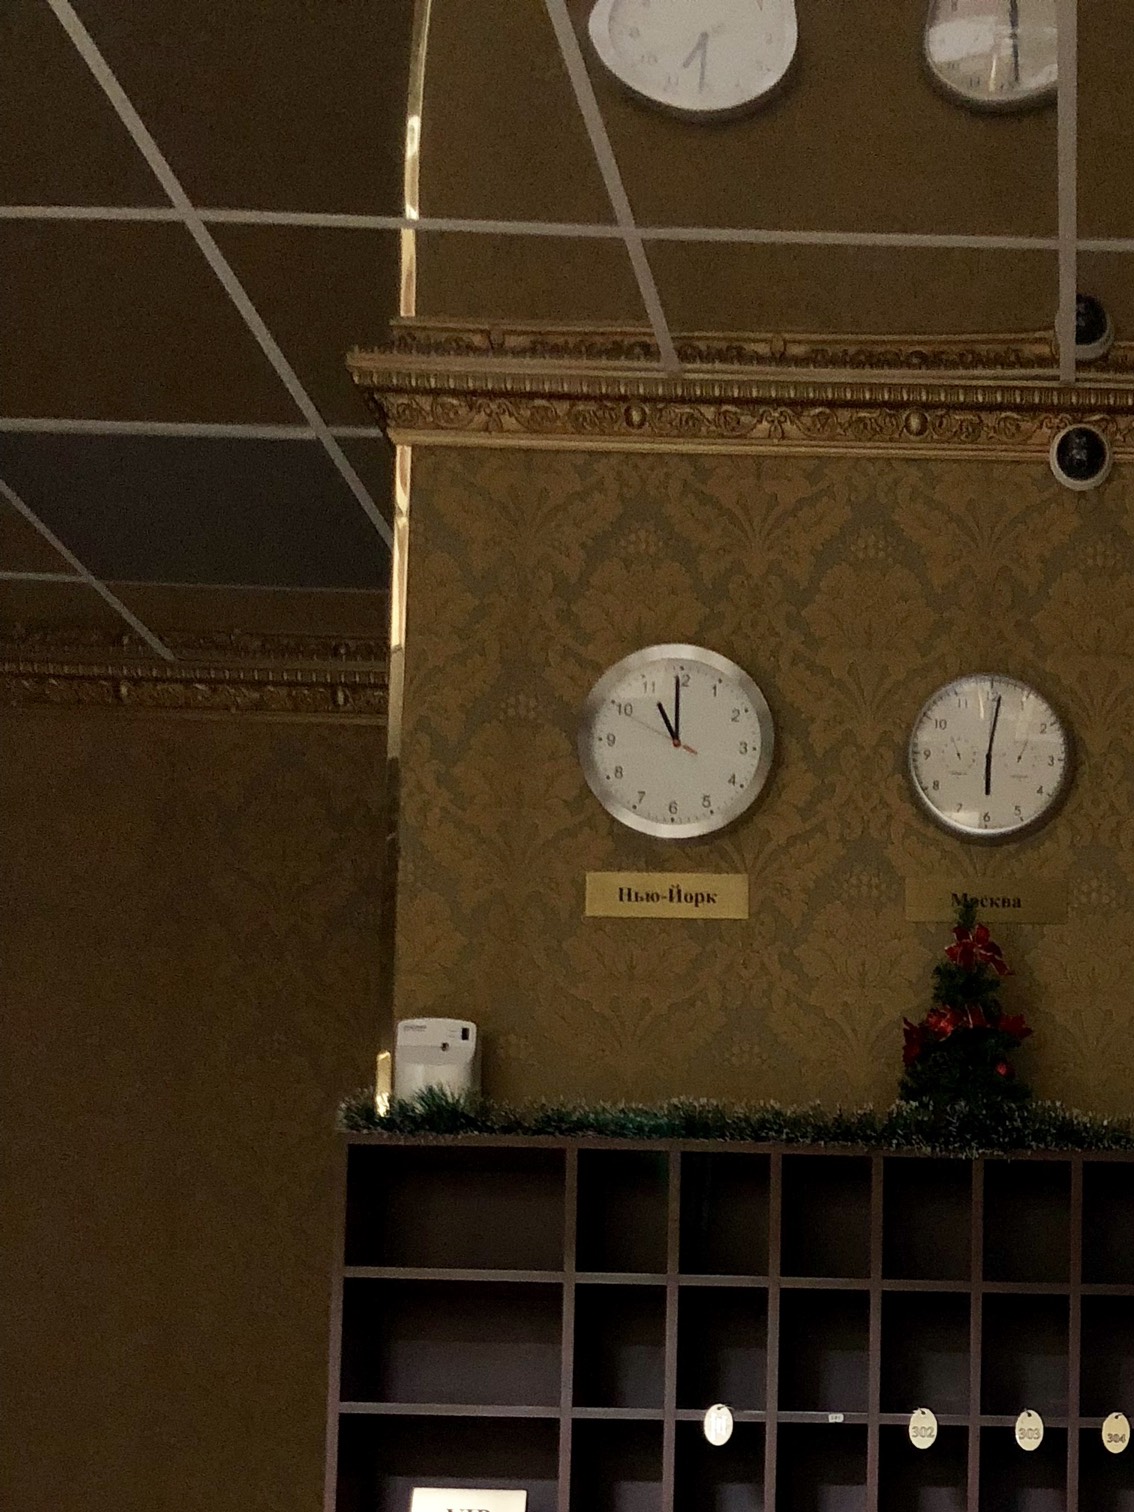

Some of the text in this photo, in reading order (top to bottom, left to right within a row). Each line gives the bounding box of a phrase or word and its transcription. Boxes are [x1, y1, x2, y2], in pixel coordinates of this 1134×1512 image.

[643, 681, 655, 694] 11
[712, 684, 718, 697] 1
[957, 698, 968, 708] 11
[616, 702, 633, 717] 10
[731, 708, 741, 722] 2
[934, 719, 947, 730] 10
[1040, 723, 1047, 734] 2
[606, 733, 616, 747] 9
[739, 741, 748, 755] 3
[923, 750, 931, 760] 9
[1048, 755, 1055, 766] 3
[614, 766, 623, 779] 8
[728, 773, 736, 786] 4
[932, 780, 940, 791] 8
[1037, 785, 1044, 795] 4
[637, 791, 646, 803] 7
[702, 795, 711, 808] 5
[668, 801, 678, 815] 6
[956, 803, 963, 813] 7
[1014, 805, 1022, 816] 5
[983, 812, 991, 822] 6
[617, 883, 718, 907] Нью-Йорк
[951, 893, 1022, 909] Москва
[911, 1426, 935, 1438] 302
[1018, 1427, 1040, 1440] 303
[1106, 1432, 1127, 1444] 304
